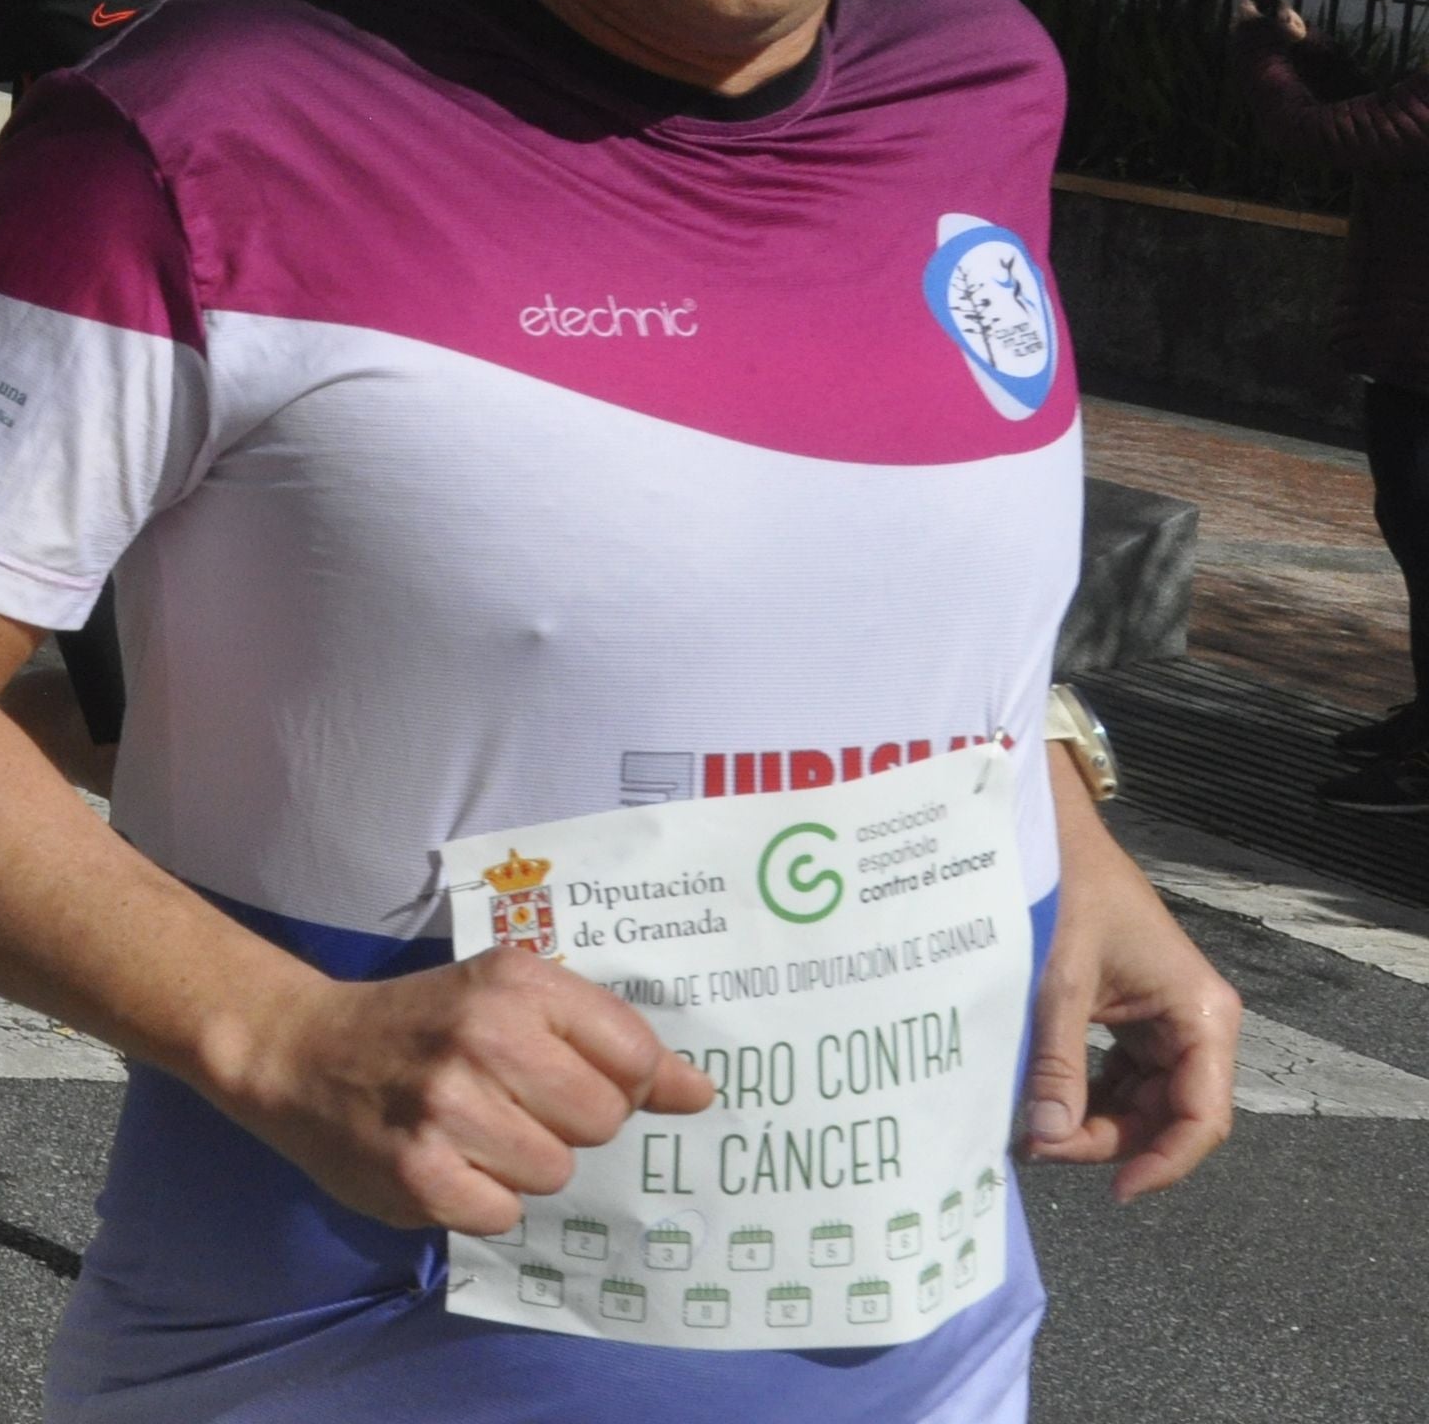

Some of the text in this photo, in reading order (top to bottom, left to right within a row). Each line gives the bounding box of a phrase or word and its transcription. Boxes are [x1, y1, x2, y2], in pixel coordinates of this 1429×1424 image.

[858, 837, 938, 875] española
[859, 849, 996, 904] contra el cáncer
[567, 871, 726, 910] Diputación
[573, 908, 728, 948] de Granada
[675, 975, 702, 1008] DE
[708, 964, 779, 1004] FONDO
[903, 936, 924, 971] DE
[928, 916, 1000, 964] GRANADA
[674, 1006, 963, 1110] RRO CONTRA
[642, 1119, 901, 1196] EL CÁNCER
